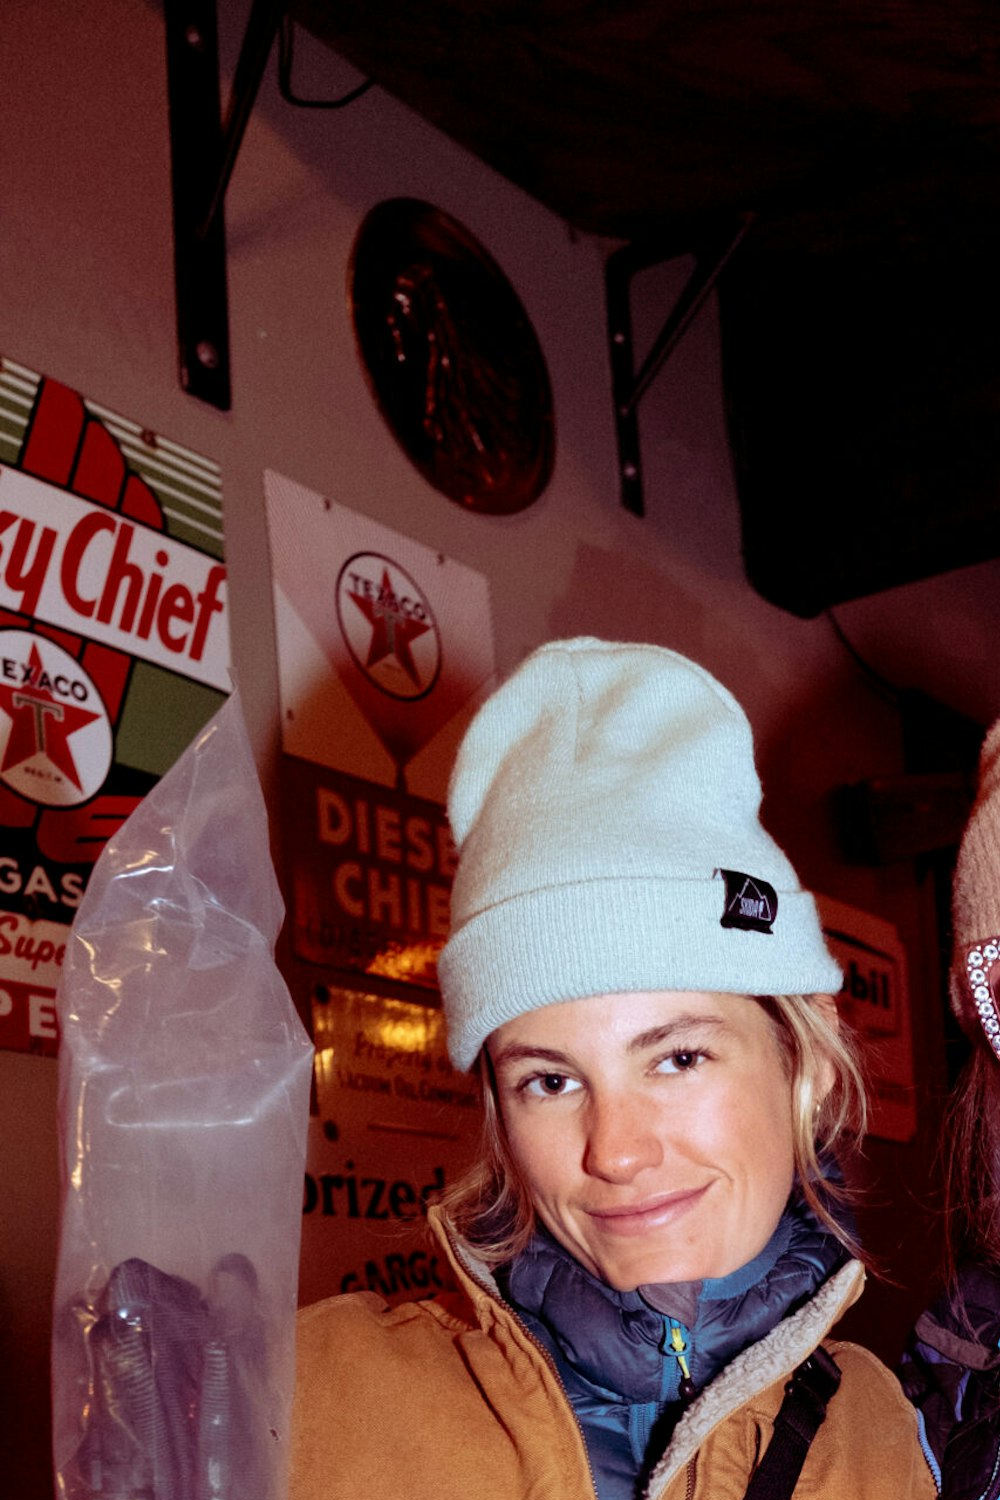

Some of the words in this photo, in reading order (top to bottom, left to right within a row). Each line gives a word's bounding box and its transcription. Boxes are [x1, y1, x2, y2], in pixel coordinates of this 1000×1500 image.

[60, 510, 226, 661] Chief
[348, 572, 426, 620] TEXACO
[842, 960, 889, 1009] bil
